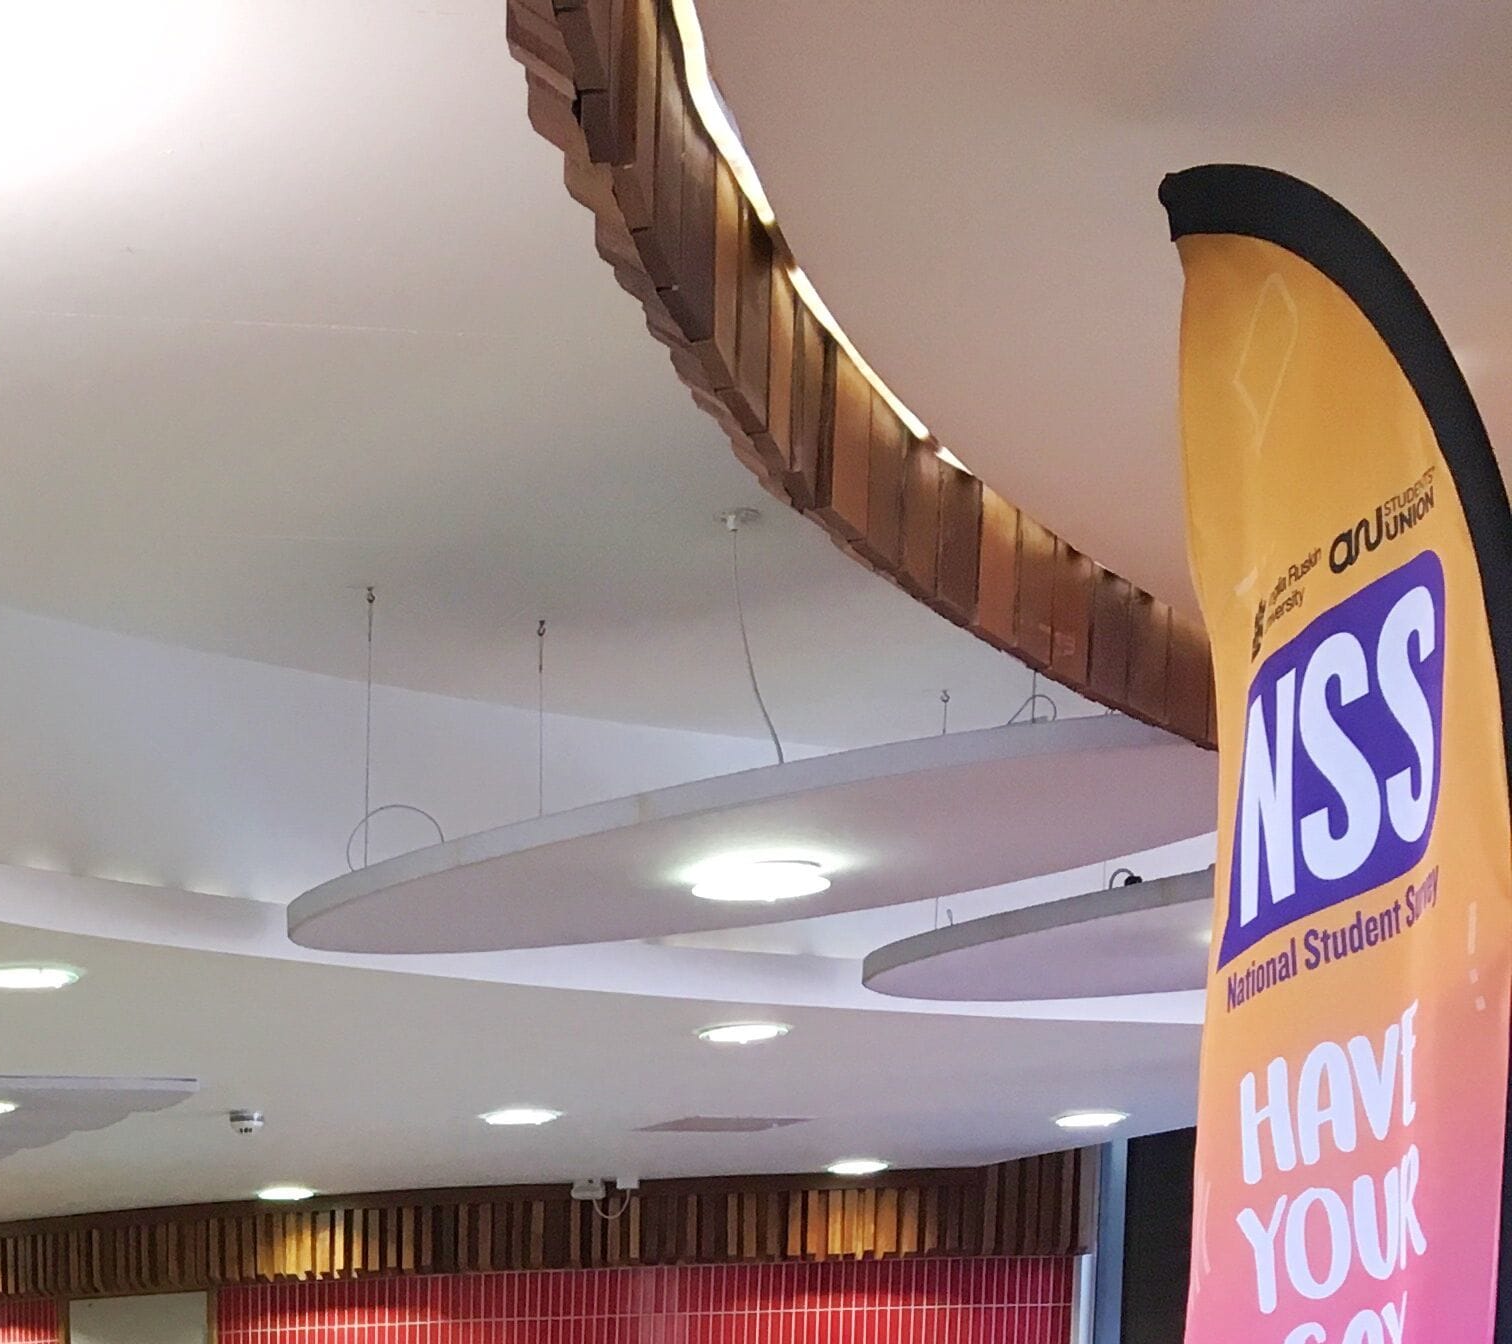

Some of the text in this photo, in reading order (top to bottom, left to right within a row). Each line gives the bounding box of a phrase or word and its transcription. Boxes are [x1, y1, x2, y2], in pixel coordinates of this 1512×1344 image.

[1385, 486, 1435, 541] UNION
[1240, 586, 1436, 928] NSS
[1227, 937, 1298, 1014] National
[1304, 899, 1401, 971] Student
[1240, 1000, 1419, 1185] HAVE
[1236, 1144, 1427, 1315] YOUR
